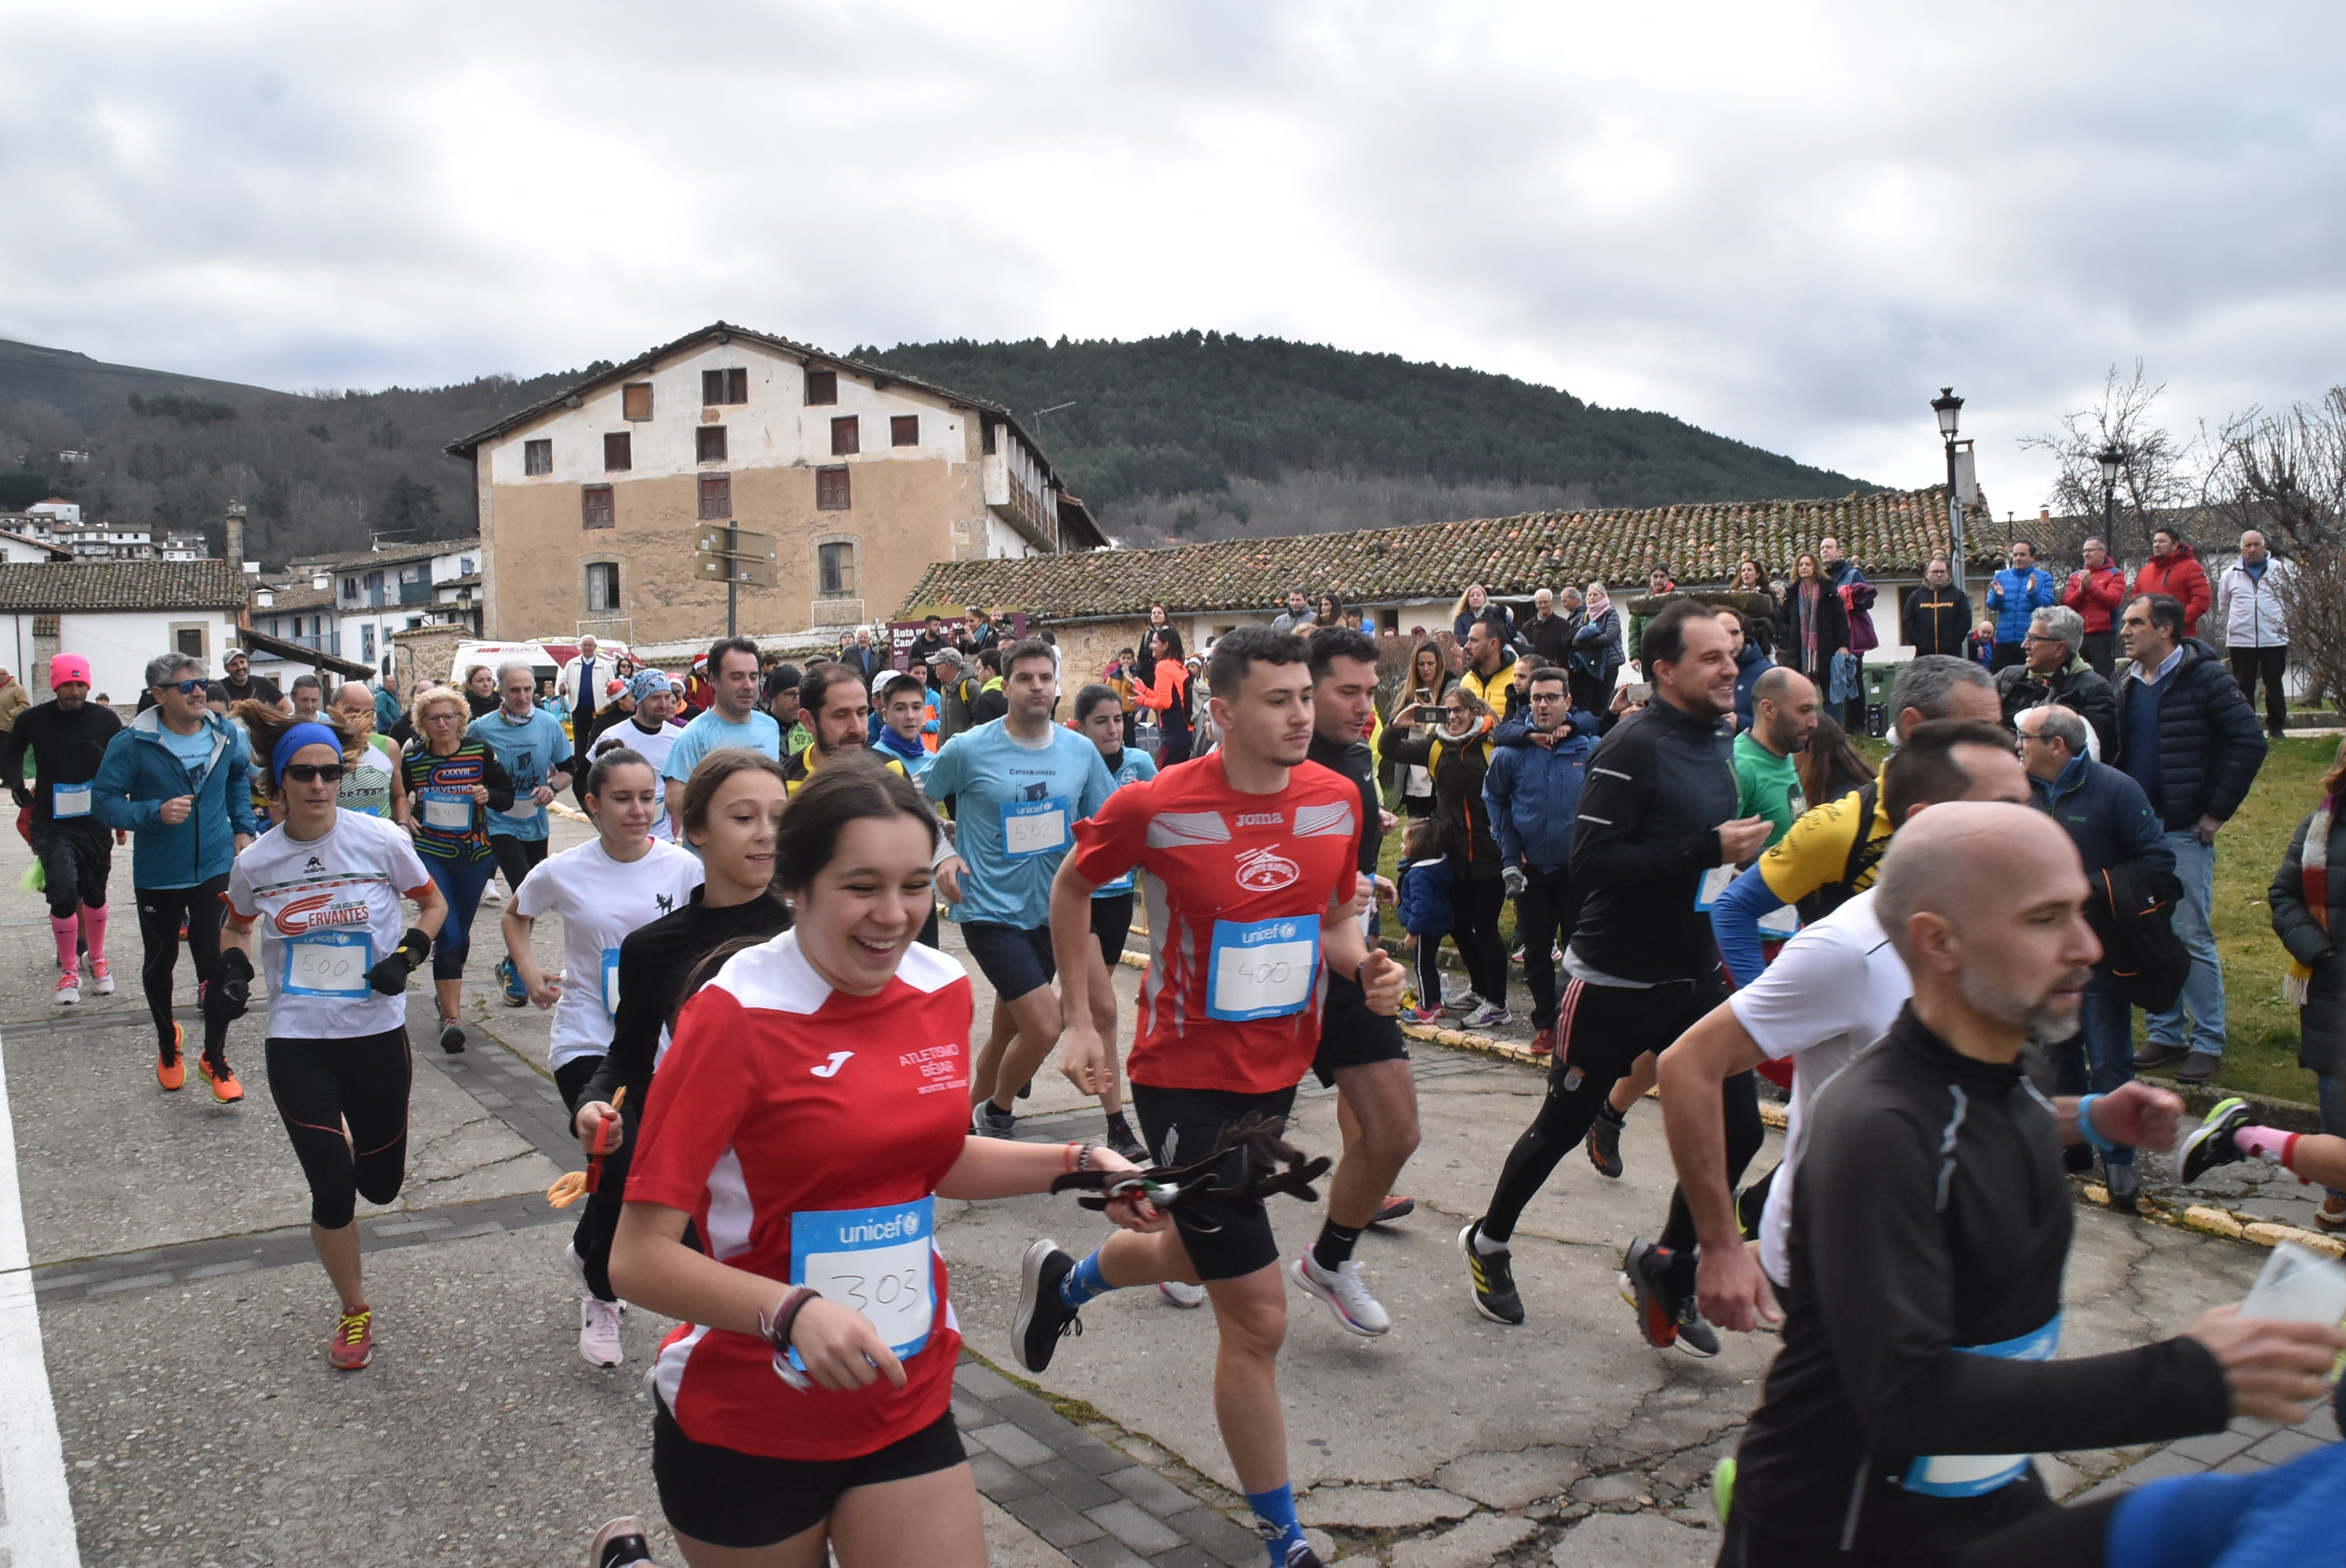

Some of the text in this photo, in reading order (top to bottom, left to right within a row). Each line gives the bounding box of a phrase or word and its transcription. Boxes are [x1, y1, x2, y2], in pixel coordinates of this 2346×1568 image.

[893, 628, 914, 638] Ruta
[441, 768, 470, 777] XXXVIII
[1017, 803, 1044, 815] unicef
[1015, 821, 1055, 840] 502
[303, 933, 336, 944] unicef
[1242, 924, 1280, 944] unicef
[301, 954, 350, 977] 500
[1238, 961, 1291, 985] 400
[899, 1044, 960, 1066] ATLETISMO
[840, 1214, 903, 1243] unicef
[830, 1269, 919, 1312] 303
